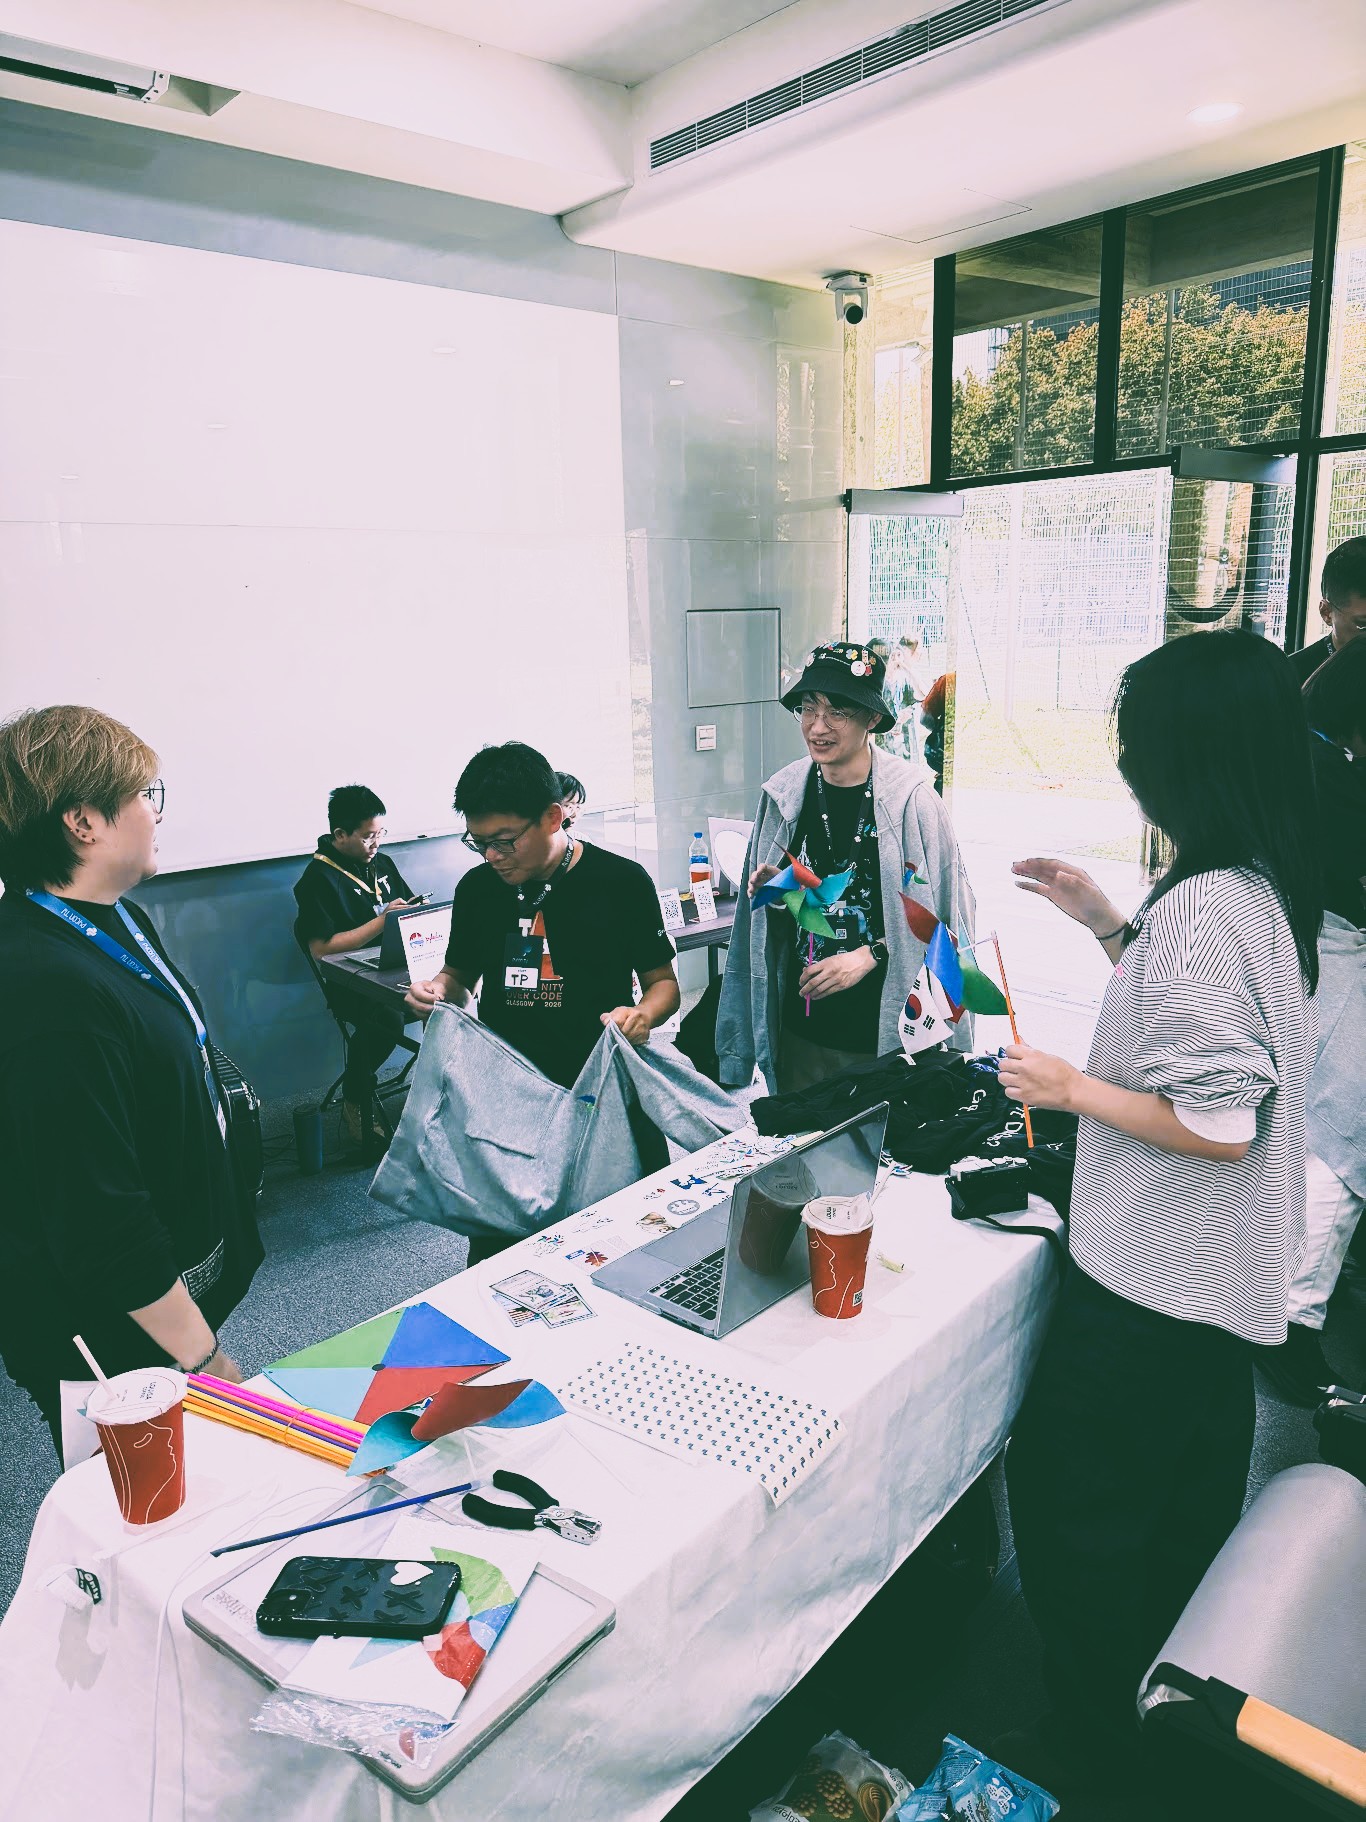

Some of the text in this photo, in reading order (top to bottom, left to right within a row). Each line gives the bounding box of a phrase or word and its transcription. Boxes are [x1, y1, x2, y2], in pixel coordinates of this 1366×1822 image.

[511, 974, 529, 985] TP
[541, 983, 564, 991] NITY
[533, 992, 562, 1000] CODE
